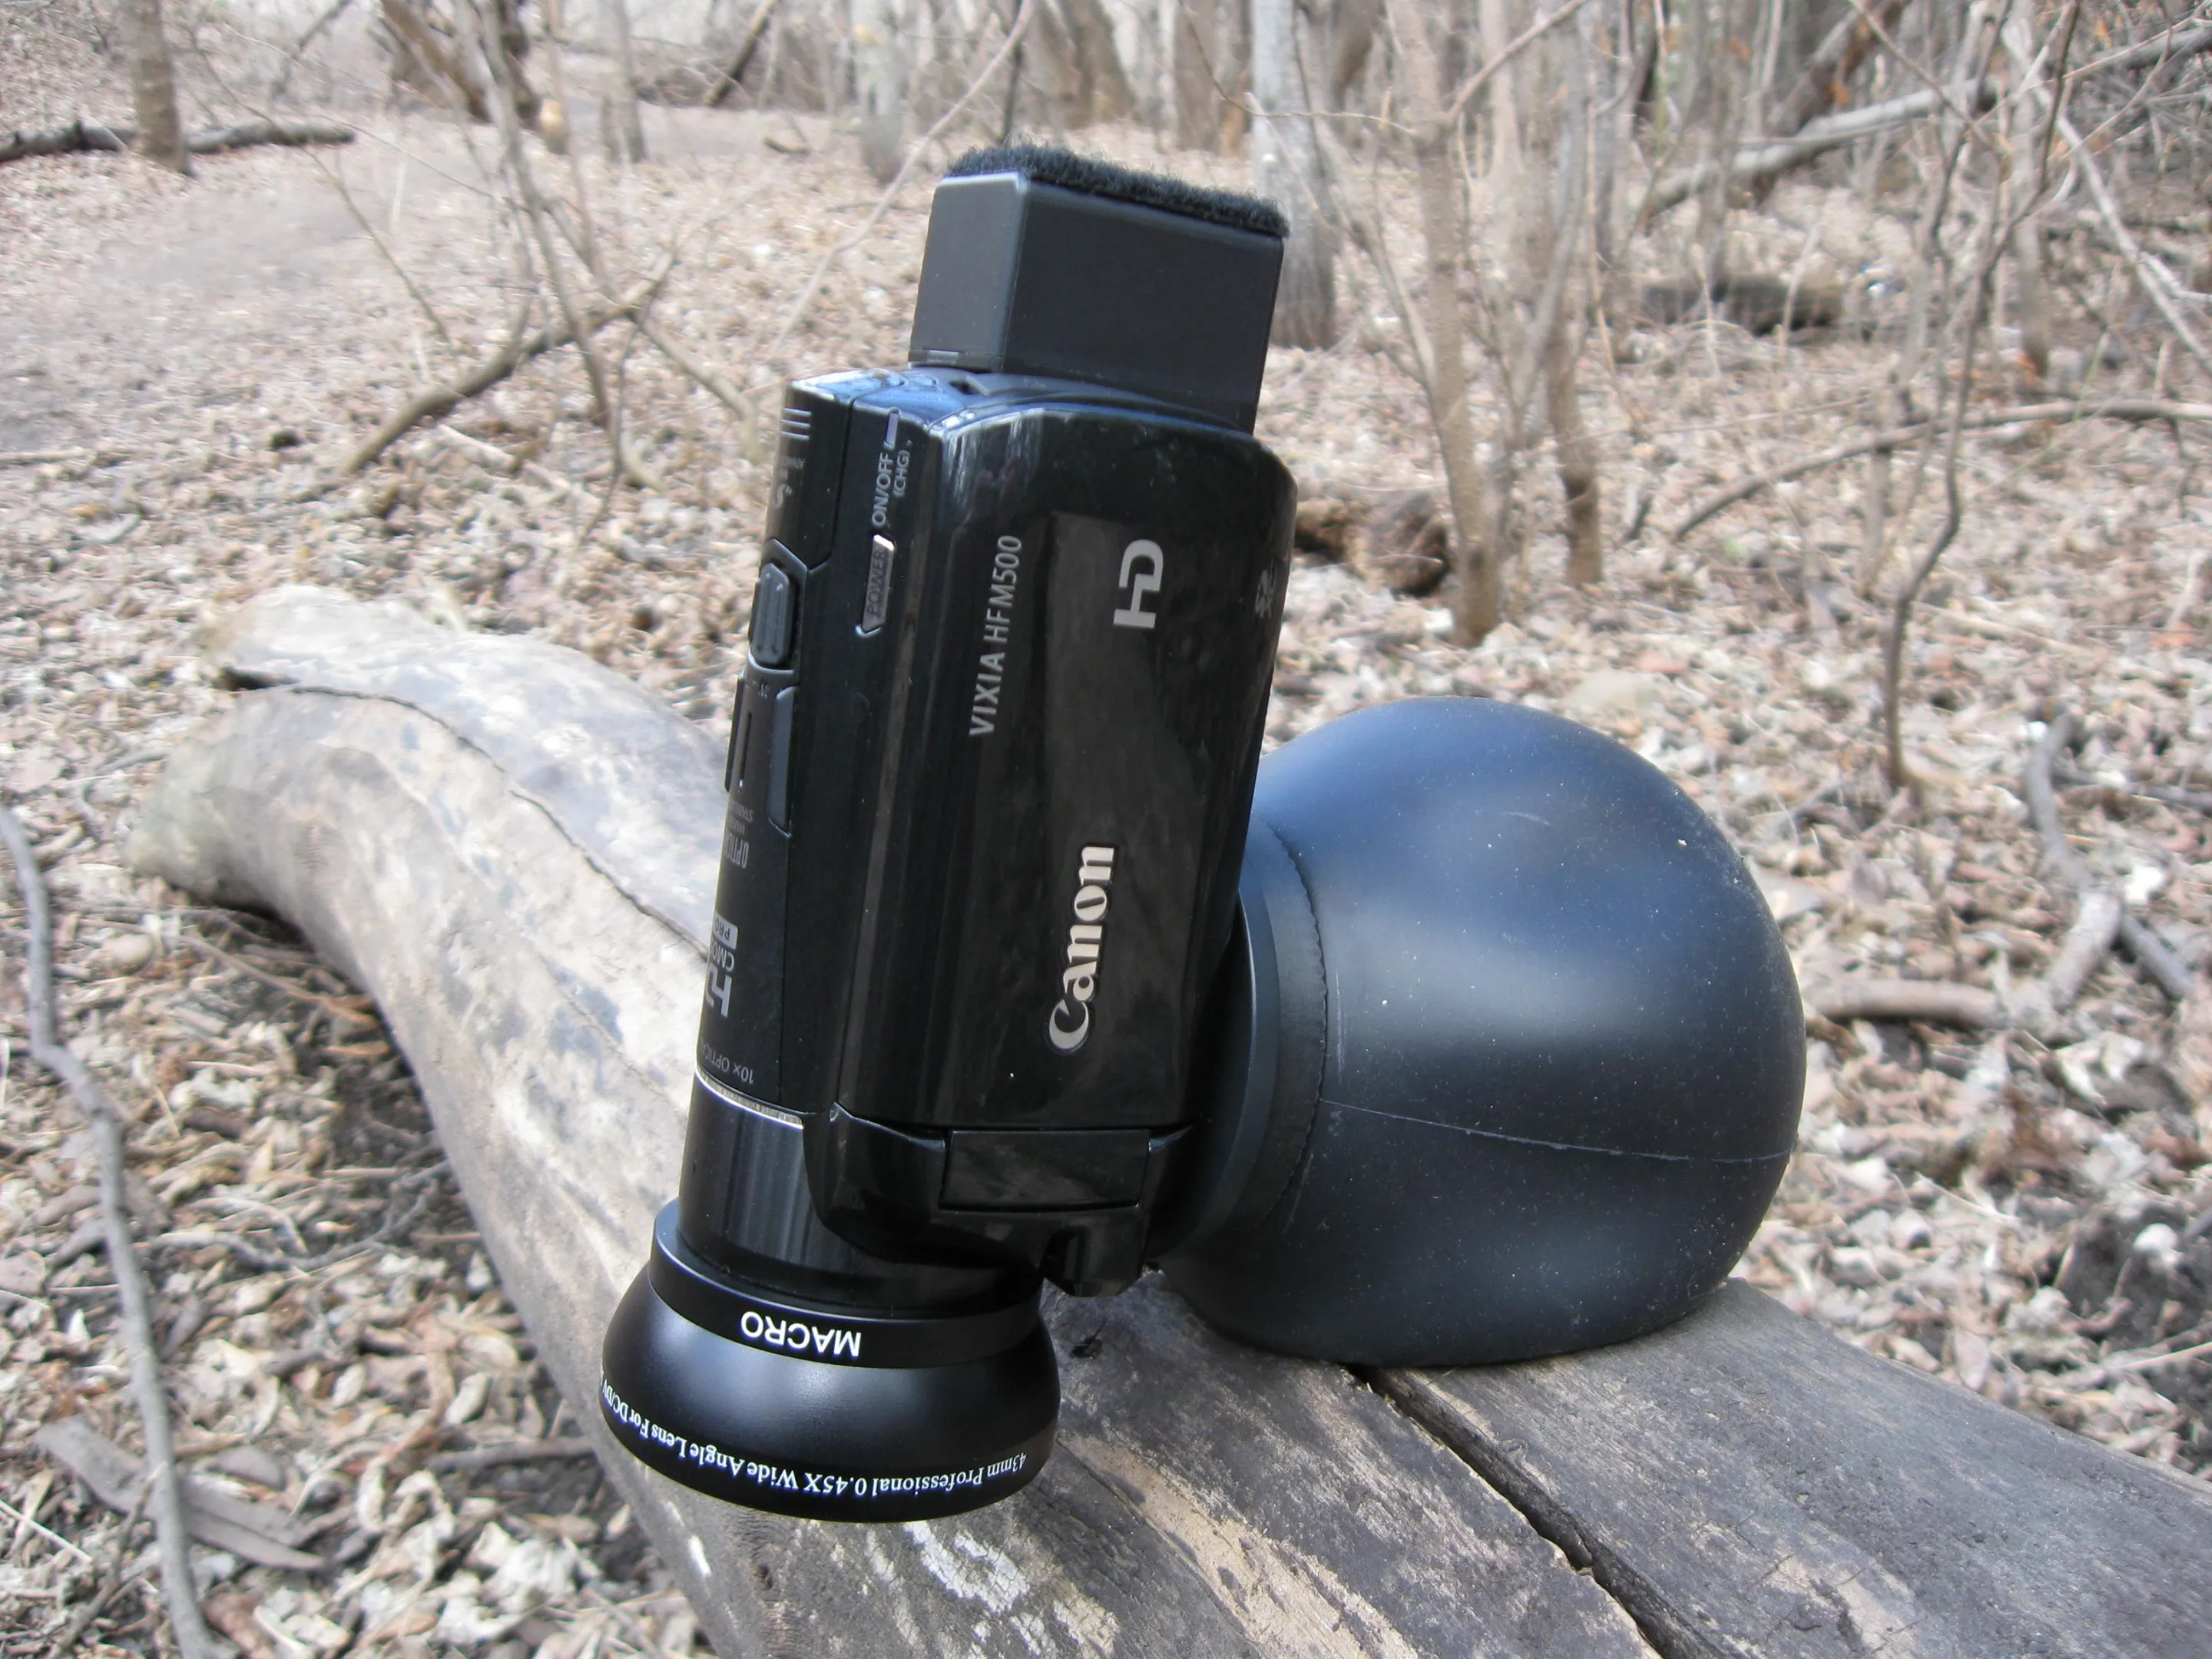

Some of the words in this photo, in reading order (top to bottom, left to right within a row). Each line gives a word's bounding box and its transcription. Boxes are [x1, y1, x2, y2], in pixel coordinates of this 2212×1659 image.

[871, 452, 893, 528] ON/OFF
[892, 450, 911, 498] (CHG)
[866, 550, 886, 617] POWER
[1113, 538, 1164, 629] HD
[969, 652, 1005, 737] VIXIA
[1048, 846, 1114, 1050] Canon
[732, 1061, 754, 1084] 10x
[740, 1310, 862, 1357] MACRO
[602, 1379, 630, 1423] DC/DV
[628, 1409, 649, 1439] For
[651, 1423, 687, 1459] Lens
[689, 1445, 746, 1477] Angle
[746, 1462, 800, 1490] Wide
[986, 1452, 1028, 1478] 43mm
[803, 1472, 868, 1496] 0.45X
[871, 1466, 985, 1497] Professional
